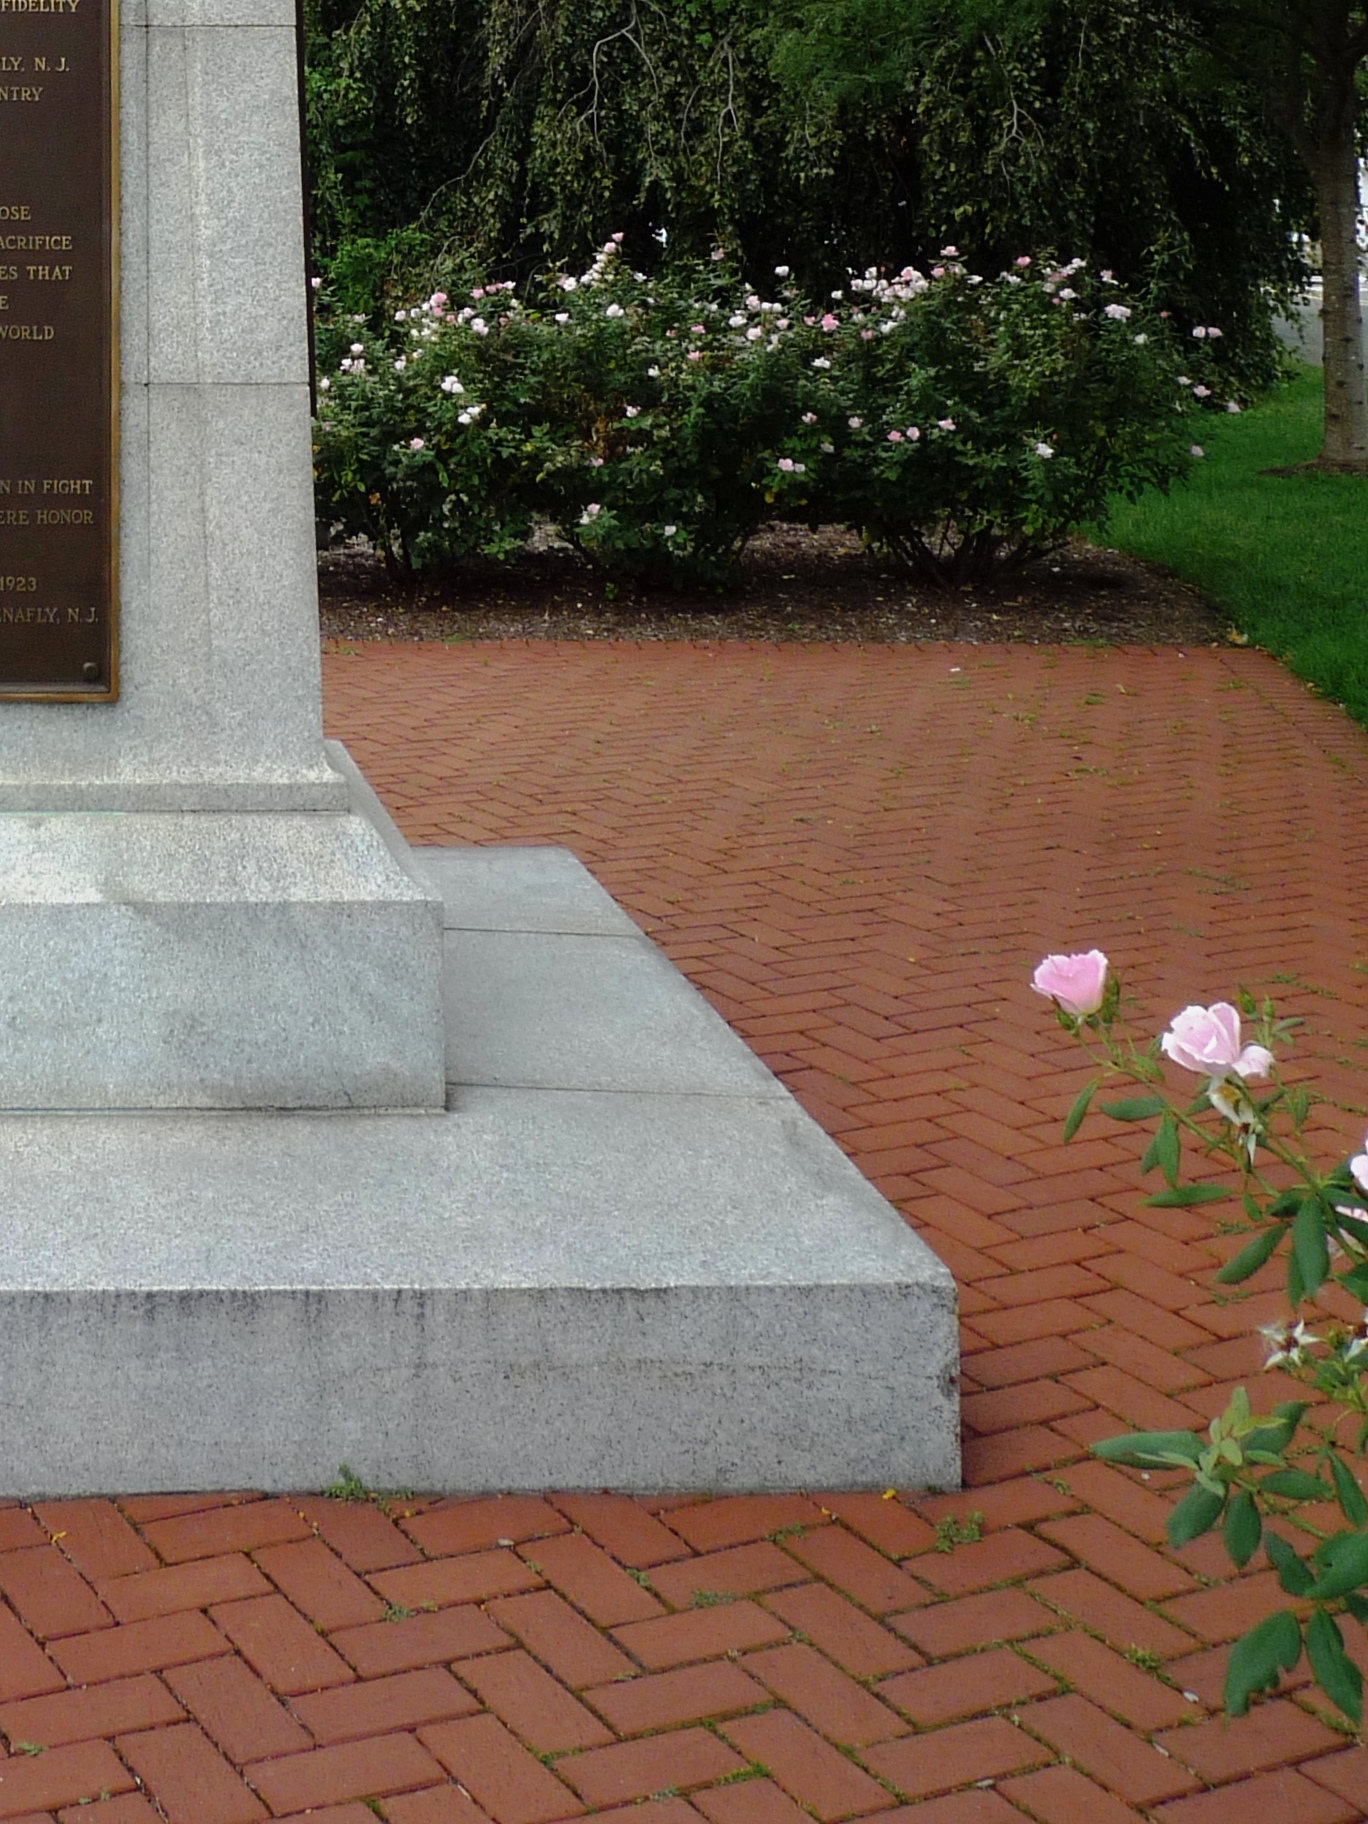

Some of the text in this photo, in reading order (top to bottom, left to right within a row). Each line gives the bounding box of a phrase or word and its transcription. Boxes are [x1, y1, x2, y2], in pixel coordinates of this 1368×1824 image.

[34, 56, 51, 72] N.
[55, 57, 70, 72] J.
[26, 265, 73, 281] THAT
[17, 479, 36, 494] IN
[42, 479, 94, 495] FIGHT
[36, 509, 94, 525] HONOR
[0, 575, 37, 592] 1923
[67, 607, 83, 623] N.
[85, 606, 99, 623] J.
